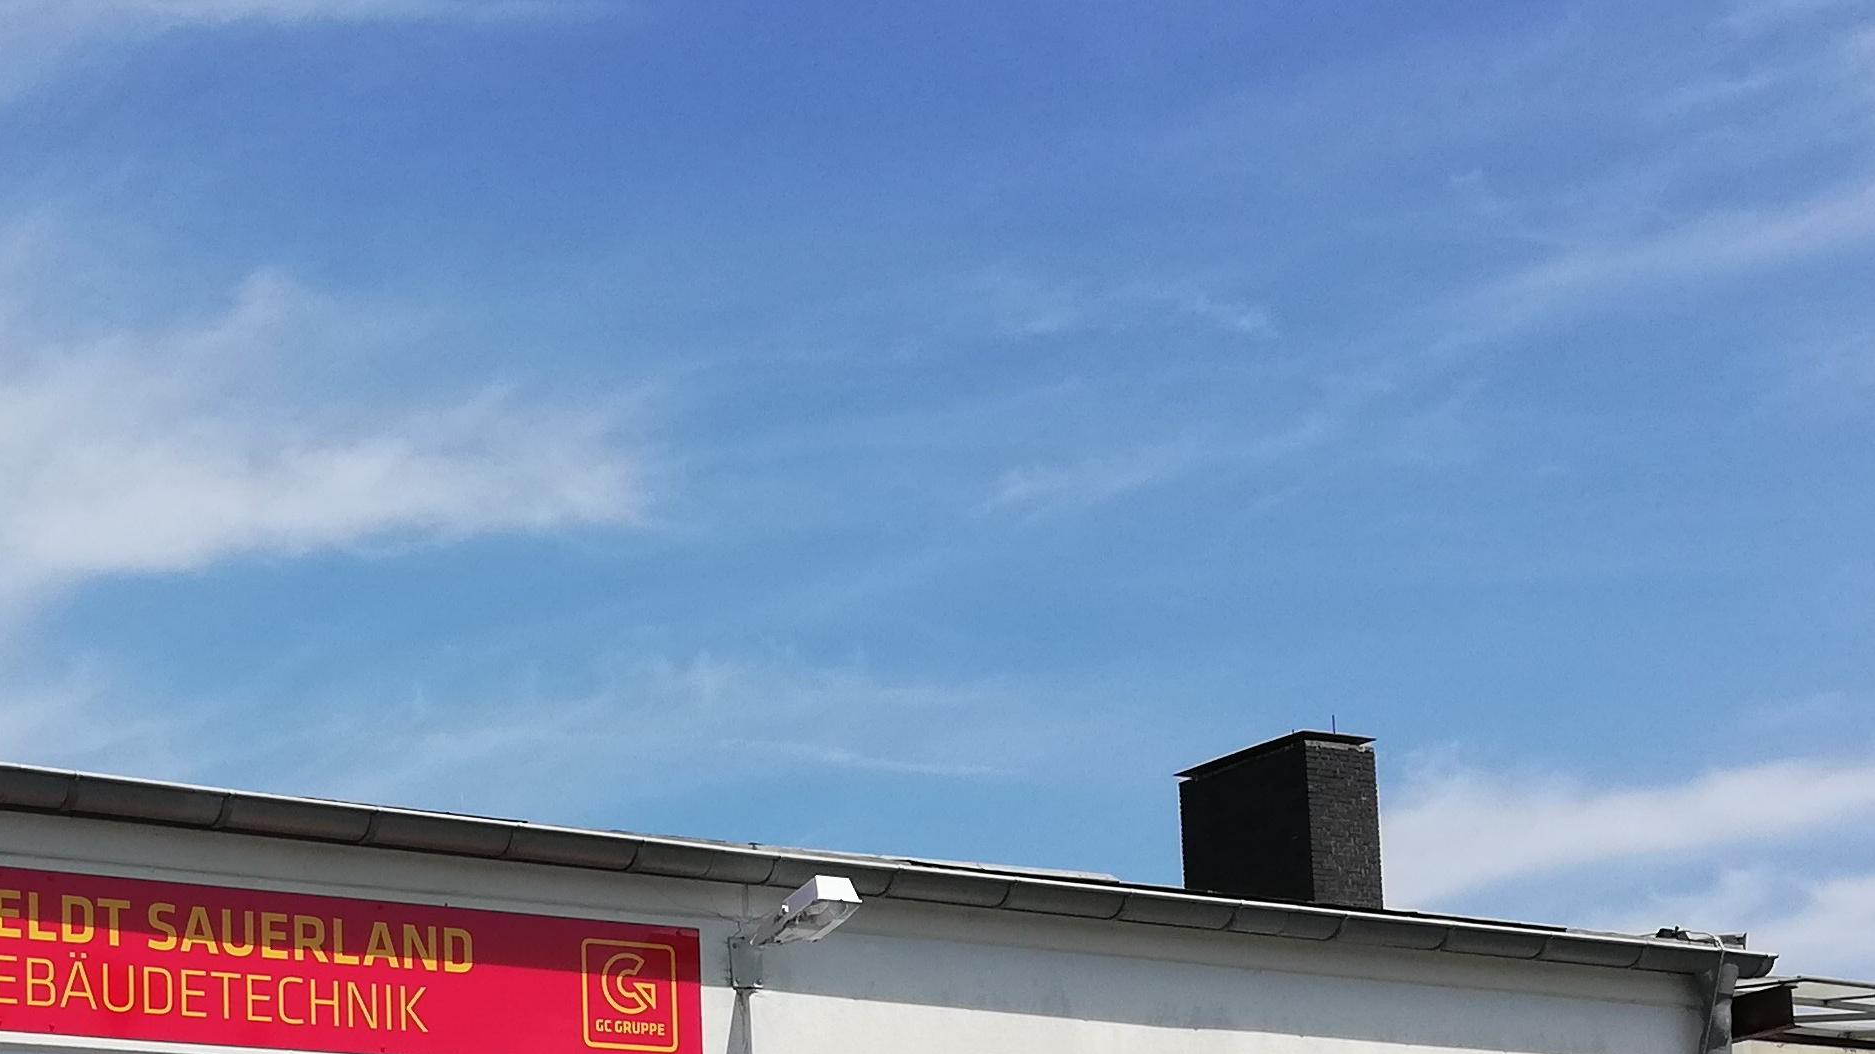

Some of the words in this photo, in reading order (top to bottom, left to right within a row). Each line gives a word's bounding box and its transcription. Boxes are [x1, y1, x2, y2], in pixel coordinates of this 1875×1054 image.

[147, 901, 475, 974] SAUERLAND
[595, 1018, 612, 1033] GC
[614, 1020, 665, 1036] GRUPPE
